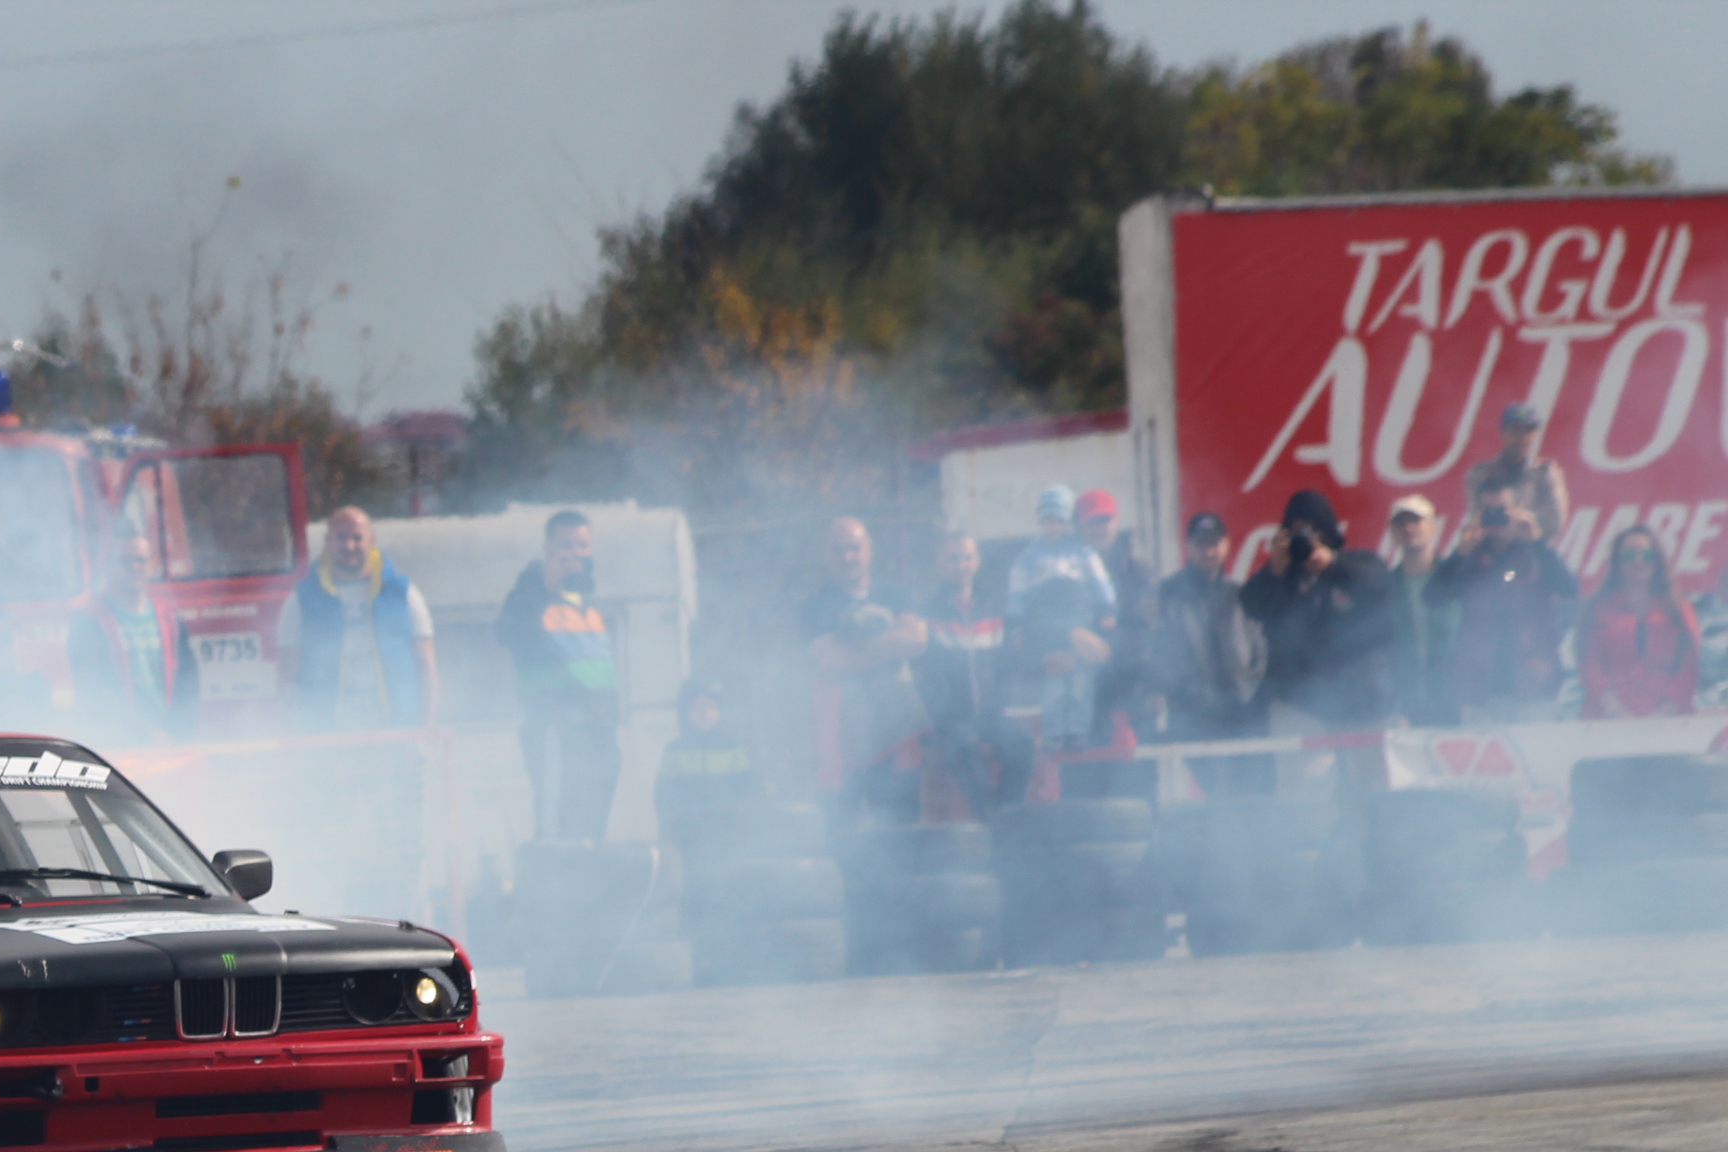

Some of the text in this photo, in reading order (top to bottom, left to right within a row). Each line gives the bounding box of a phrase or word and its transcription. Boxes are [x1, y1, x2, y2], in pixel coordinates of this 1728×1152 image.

[1341, 222, 1706, 334] TARGUL
[1242, 316, 1728, 492] AUTO
[1, 776, 31, 786] DRIFT
